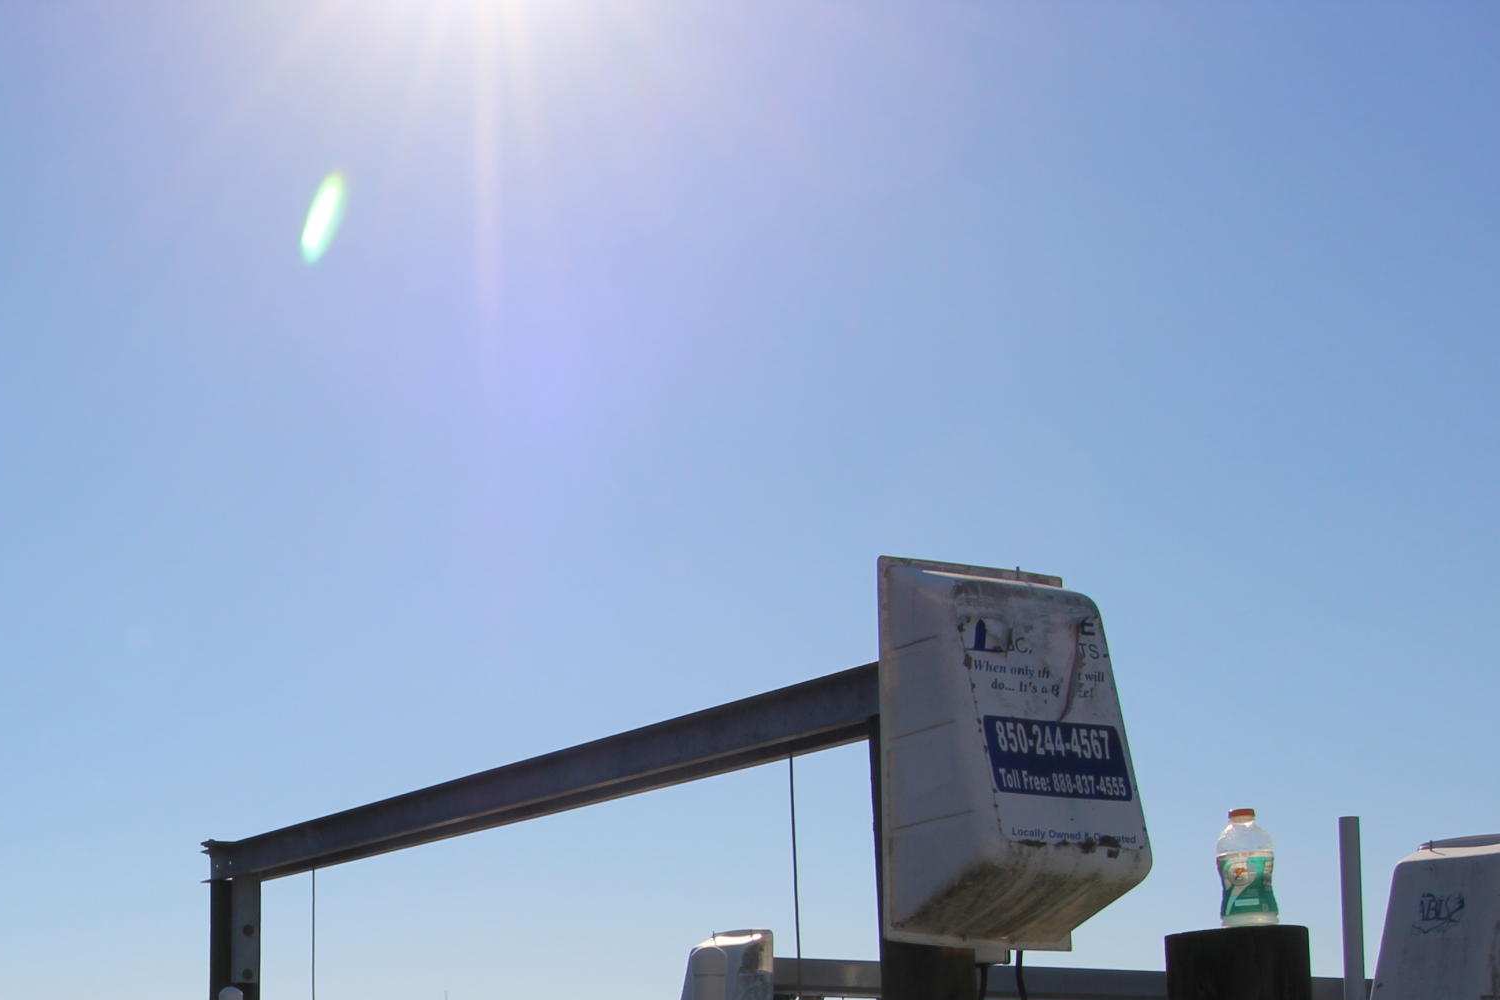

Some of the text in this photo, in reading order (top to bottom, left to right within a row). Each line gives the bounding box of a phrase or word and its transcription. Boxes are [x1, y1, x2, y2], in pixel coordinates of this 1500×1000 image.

[974, 660, 1007, 674] When
[1010, 663, 1034, 679] only
[1038, 665, 1051, 679] th
[1085, 672, 1105, 682] will
[991, 679, 1015, 691] do...
[1019, 681, 1038, 694] It's
[1041, 686, 1049, 694] a
[996, 721, 1110, 760] 850-244-4567
[999, 768, 1126, 796] Toll Free: 888-837-4555
[1012, 827, 1045, 840] Locally
[1049, 830, 1081, 841] Owned
